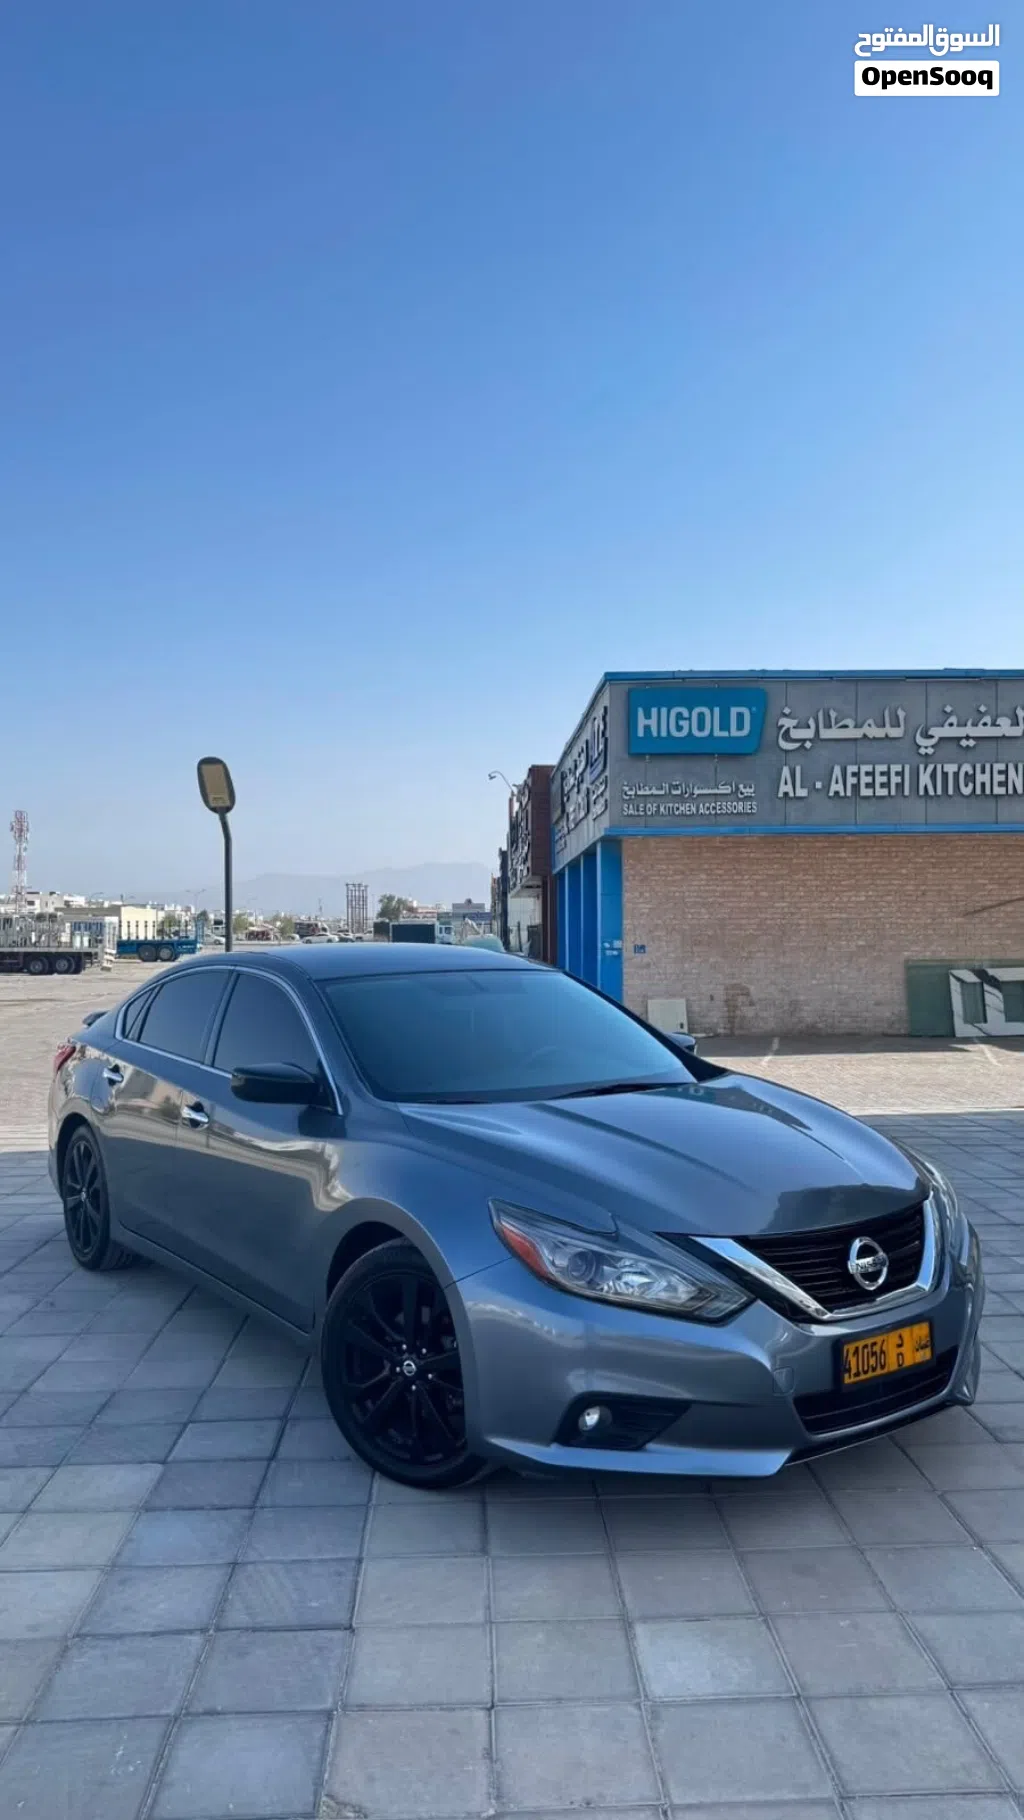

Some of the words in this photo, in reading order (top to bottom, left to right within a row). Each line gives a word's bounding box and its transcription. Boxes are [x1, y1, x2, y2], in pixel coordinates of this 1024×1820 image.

[637, 706, 751, 738] HIGOLD
[777, 705, 906, 751] للمطابخ
[622, 780, 669, 800] المطابخ
[737, 782, 756, 799] بيع
[777, 765, 809, 798] AL
[828, 764, 910, 797] AFEEFI
[918, 762, 1024, 796] KITCHEN
[622, 803, 645, 816] SALE
[645, 803, 658, 816] OF
[660, 802, 697, 816] KITCHEN
[699, 801, 758, 815] ACCESSORIES
[843, 1338, 887, 1379] 41056
